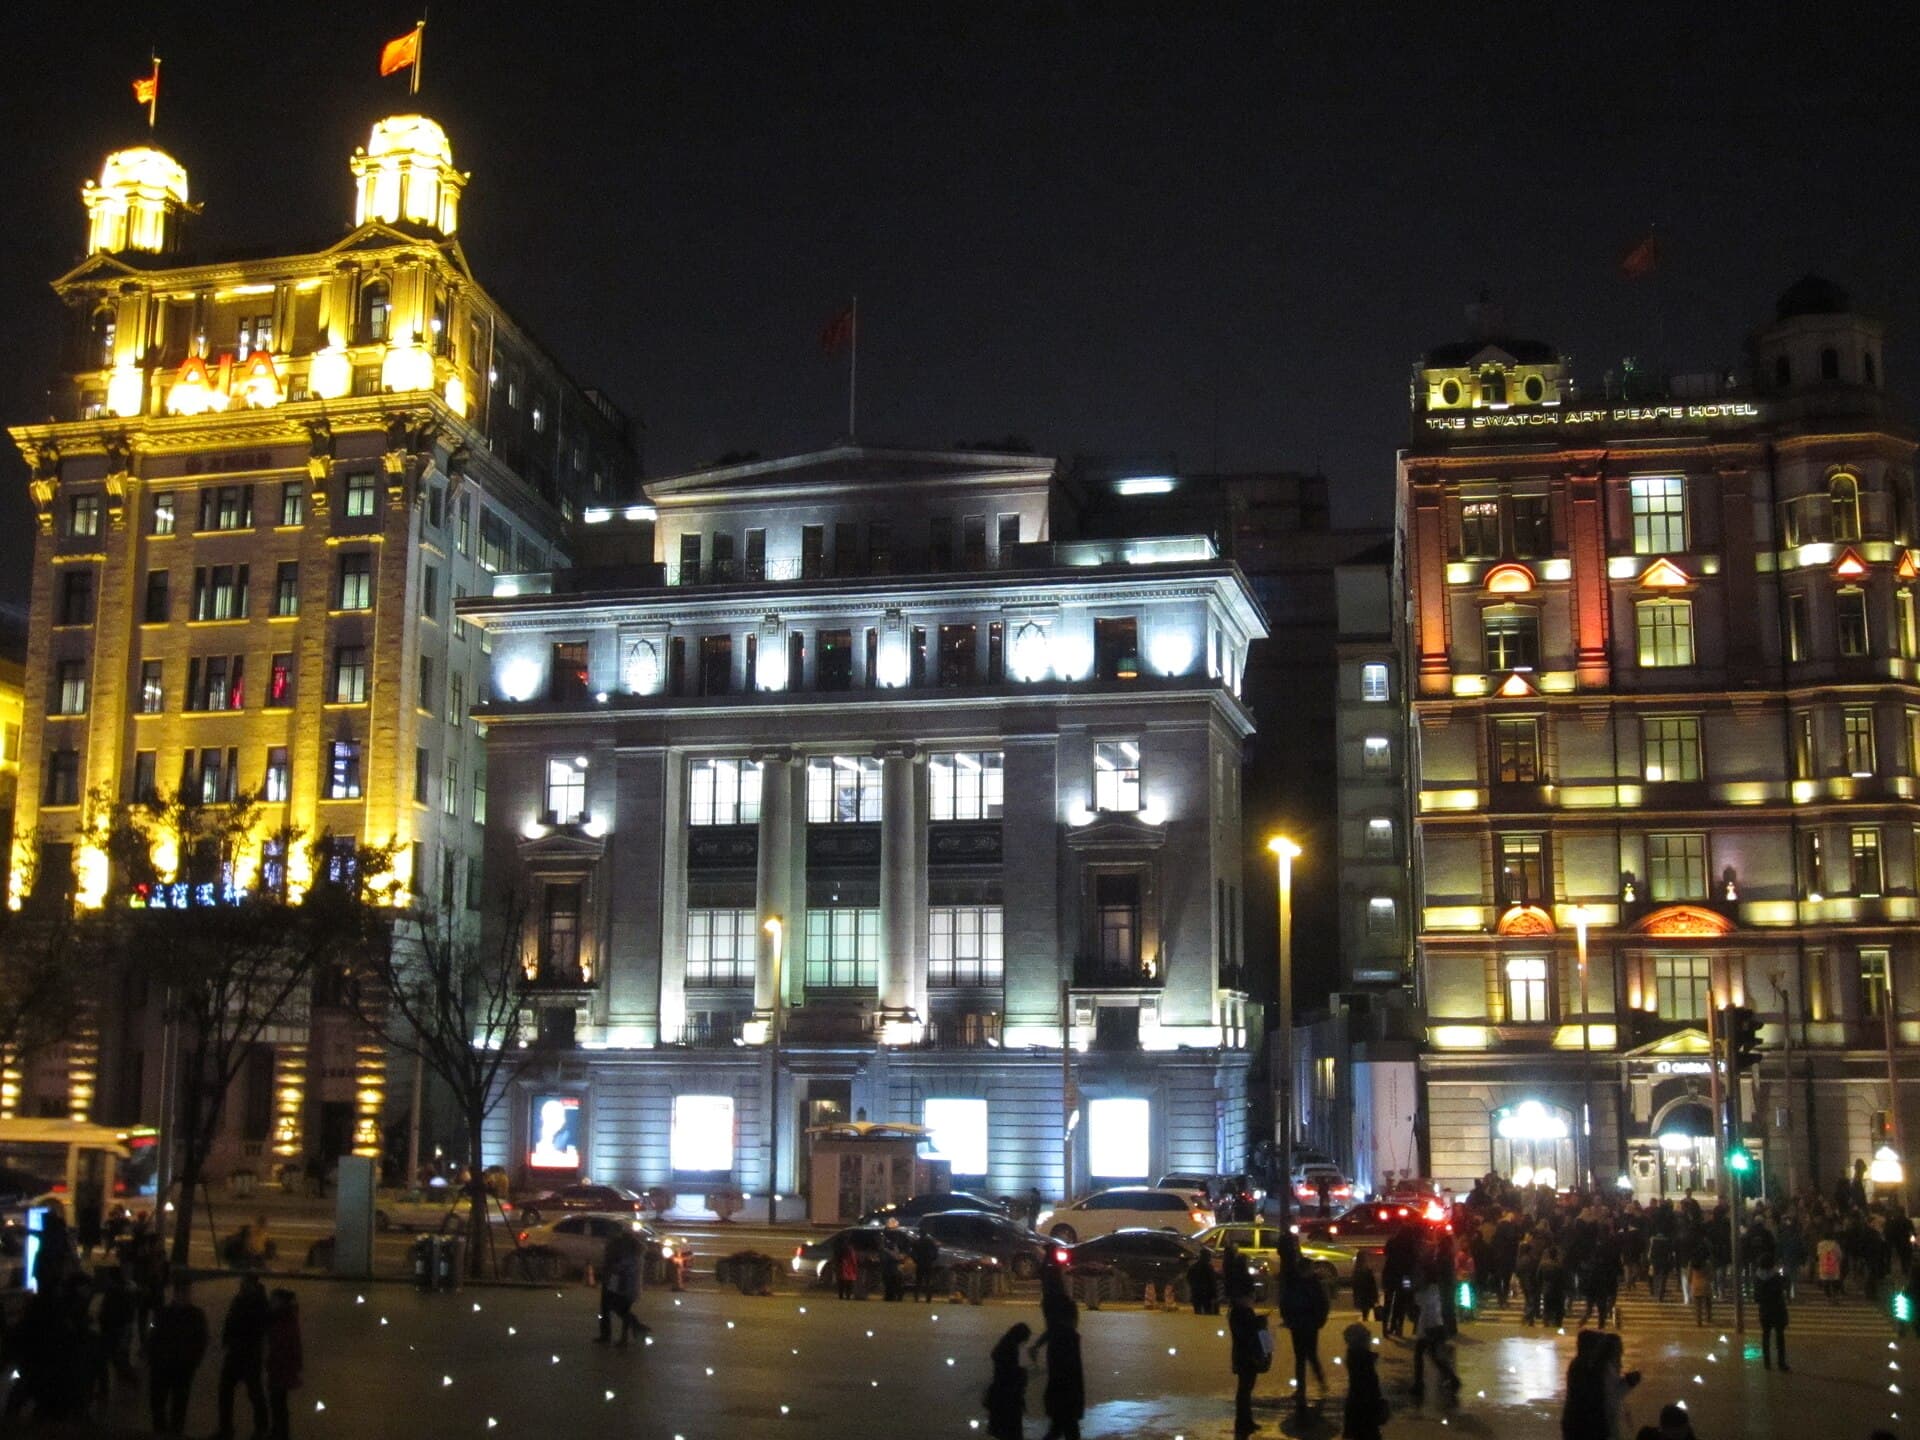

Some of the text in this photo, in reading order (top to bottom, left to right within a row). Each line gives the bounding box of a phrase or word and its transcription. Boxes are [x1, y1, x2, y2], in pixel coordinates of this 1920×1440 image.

[1426, 403, 1758, 429] THE SWATCH ART PEACE HOTEL
